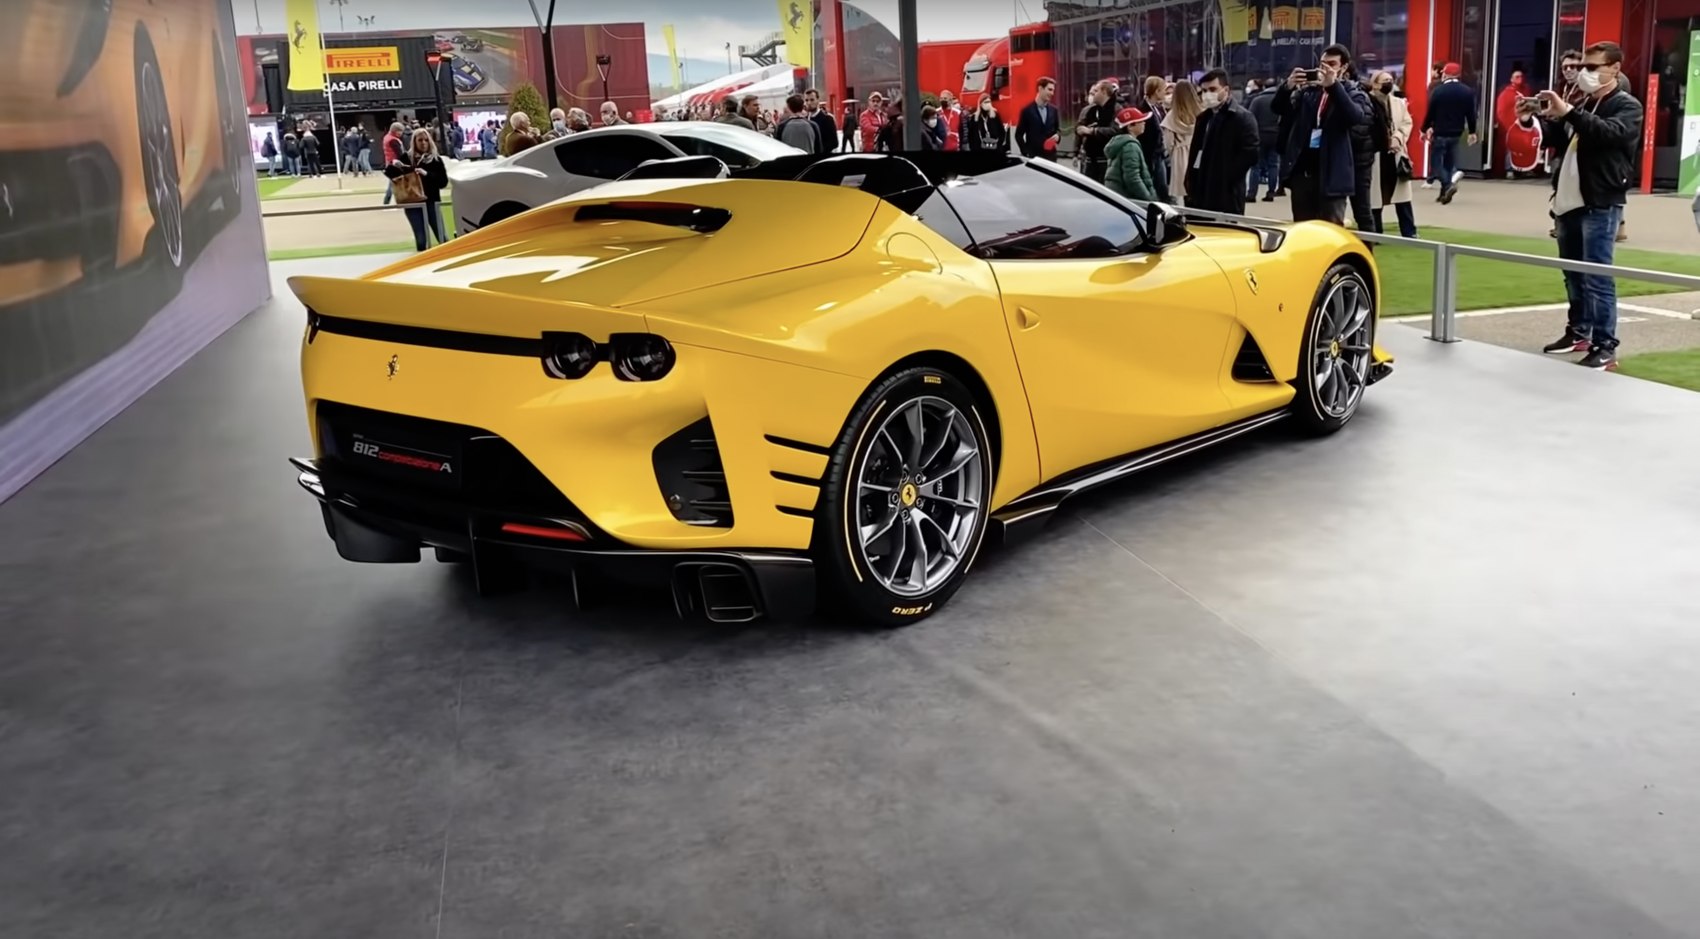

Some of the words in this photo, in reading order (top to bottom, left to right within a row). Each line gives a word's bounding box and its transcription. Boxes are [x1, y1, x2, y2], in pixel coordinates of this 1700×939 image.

[326, 52, 391, 69] PIRELLI
[322, 81, 356, 92] CASA
[358, 80, 402, 90] PIRELLI
[353, 441, 379, 457] 812
[891, 606, 924, 615] ZERO
